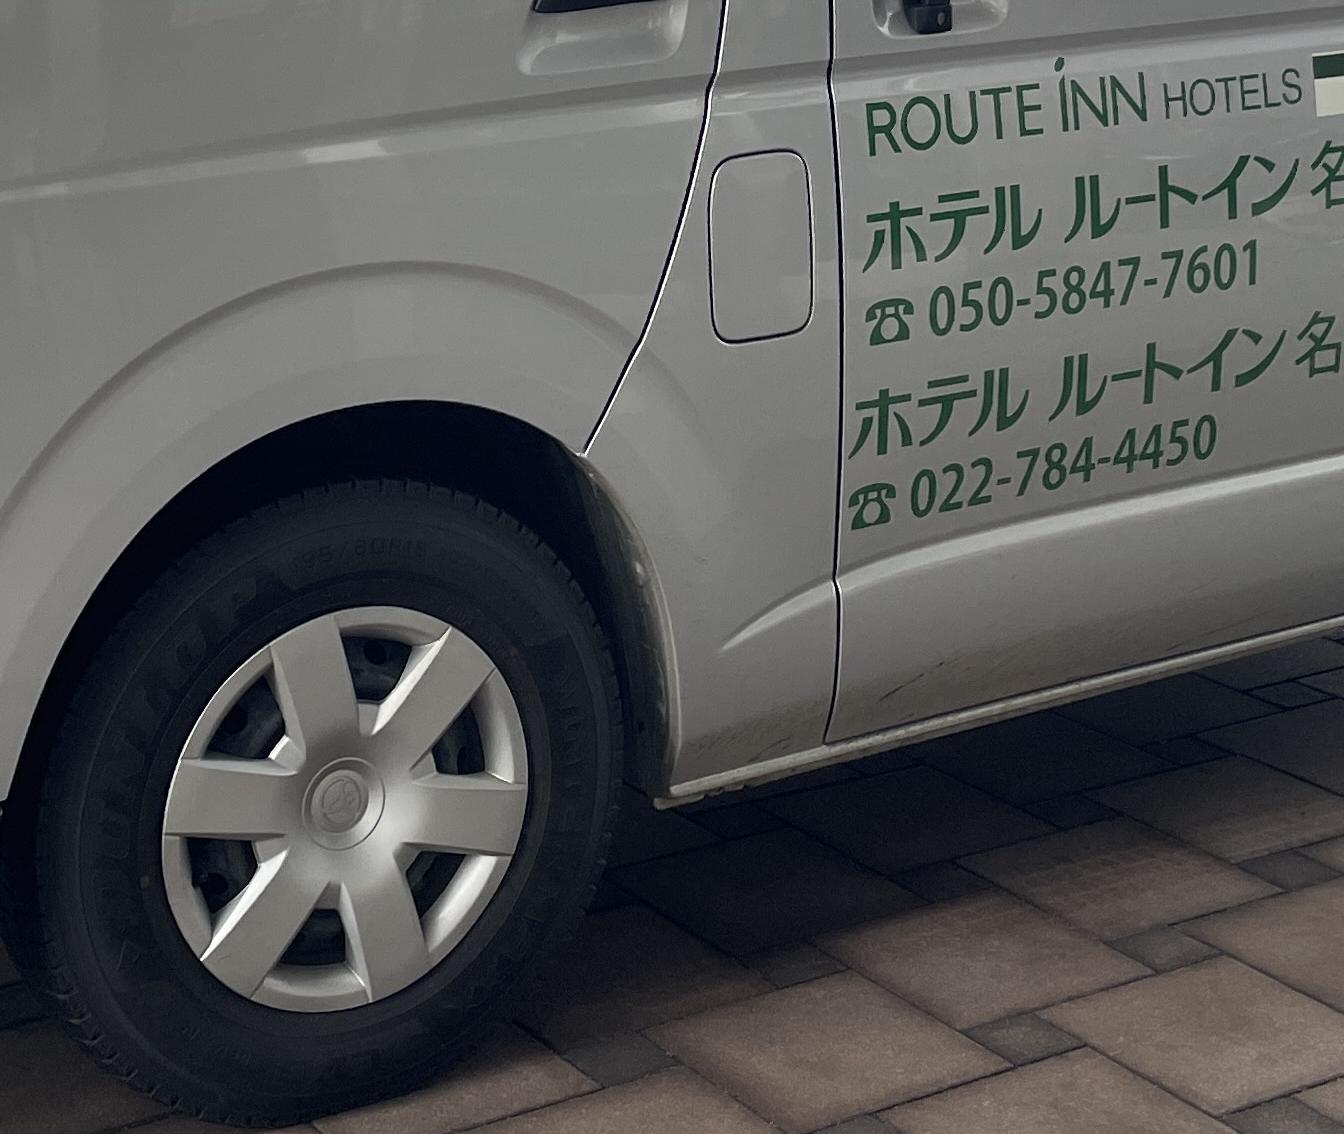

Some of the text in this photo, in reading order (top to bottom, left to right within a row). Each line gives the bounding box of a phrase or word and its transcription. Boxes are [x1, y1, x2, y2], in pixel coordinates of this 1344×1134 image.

[866, 83, 1044, 156] ROUTE
[1163, 68, 1303, 119] HOTELS
[862, 184, 1043, 273] ホテル
[929, 239, 1257, 337] 050-5847-7601
[848, 367, 1029, 460] ホテル
[910, 415, 1217, 518] 022-784-4450
